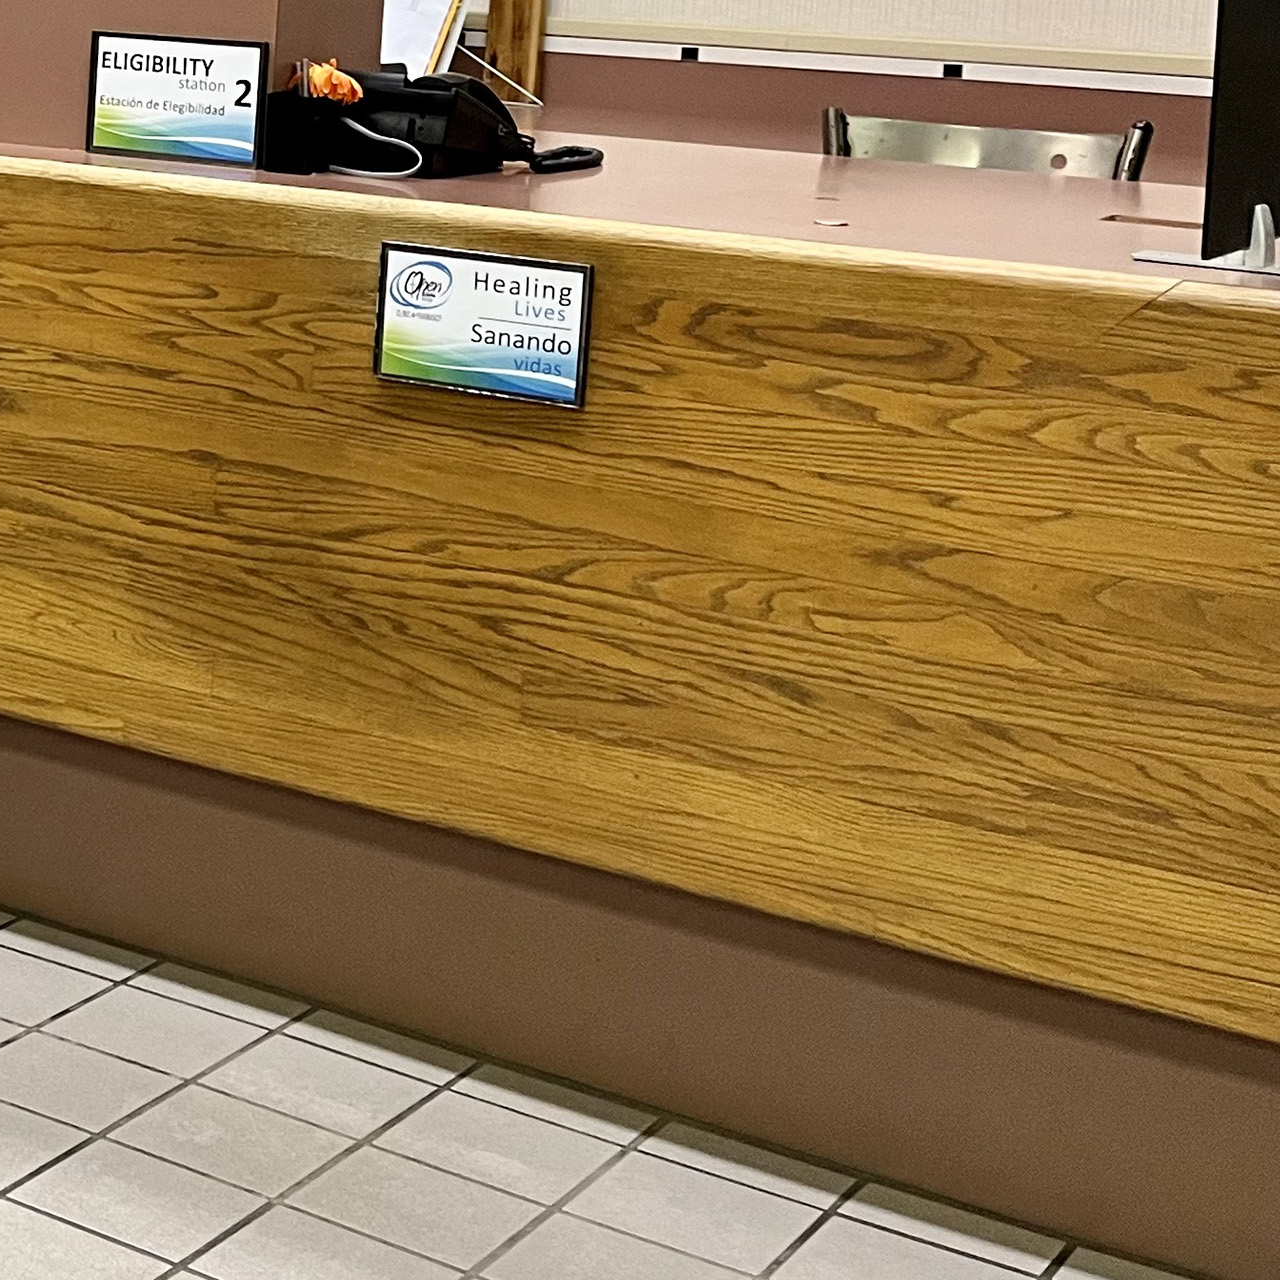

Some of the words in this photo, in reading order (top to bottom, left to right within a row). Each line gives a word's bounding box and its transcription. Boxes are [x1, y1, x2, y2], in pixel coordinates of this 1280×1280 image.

[101, 51, 215, 77] ELIGIBILITY
[178, 78, 226, 93] station
[234, 79, 252, 108] 2
[99, 94, 143, 109] Estación
[145, 99, 160, 110] de
[162, 100, 226, 117] Elegibilidad
[404, 271, 443, 301] Open
[473, 271, 573, 307] Healing
[514, 300, 566, 322] Lives
[470, 323, 572, 355] Sanando
[513, 356, 562, 377] vidas
